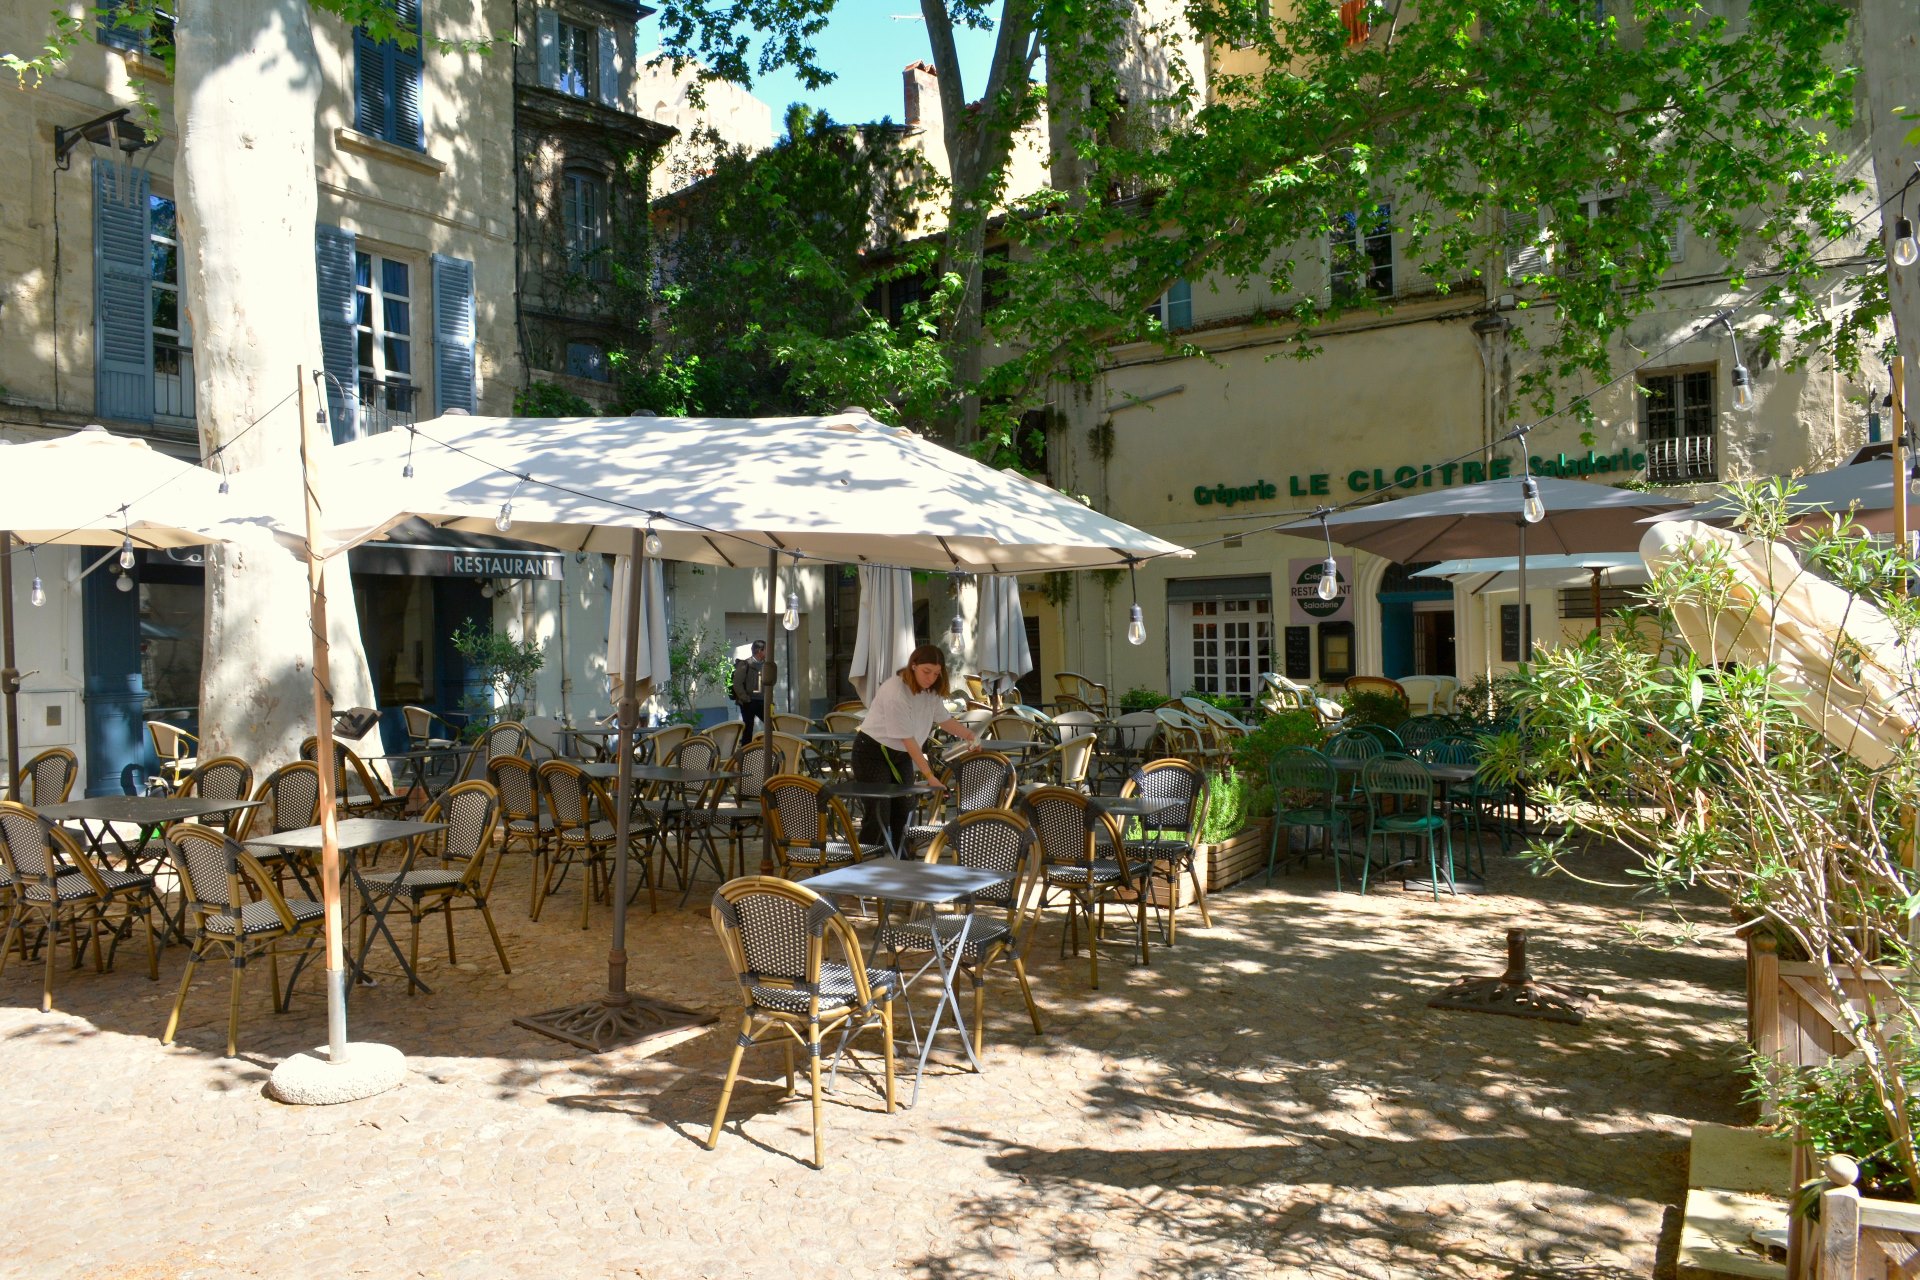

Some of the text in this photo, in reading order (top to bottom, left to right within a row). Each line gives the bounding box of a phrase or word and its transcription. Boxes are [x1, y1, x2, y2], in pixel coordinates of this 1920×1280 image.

[1194, 447, 1646, 507] Crêperie LE CLOITRE Saladerie
[453, 555, 554, 576] RESTAURANT
[1291, 585, 1351, 597] RESTANT
